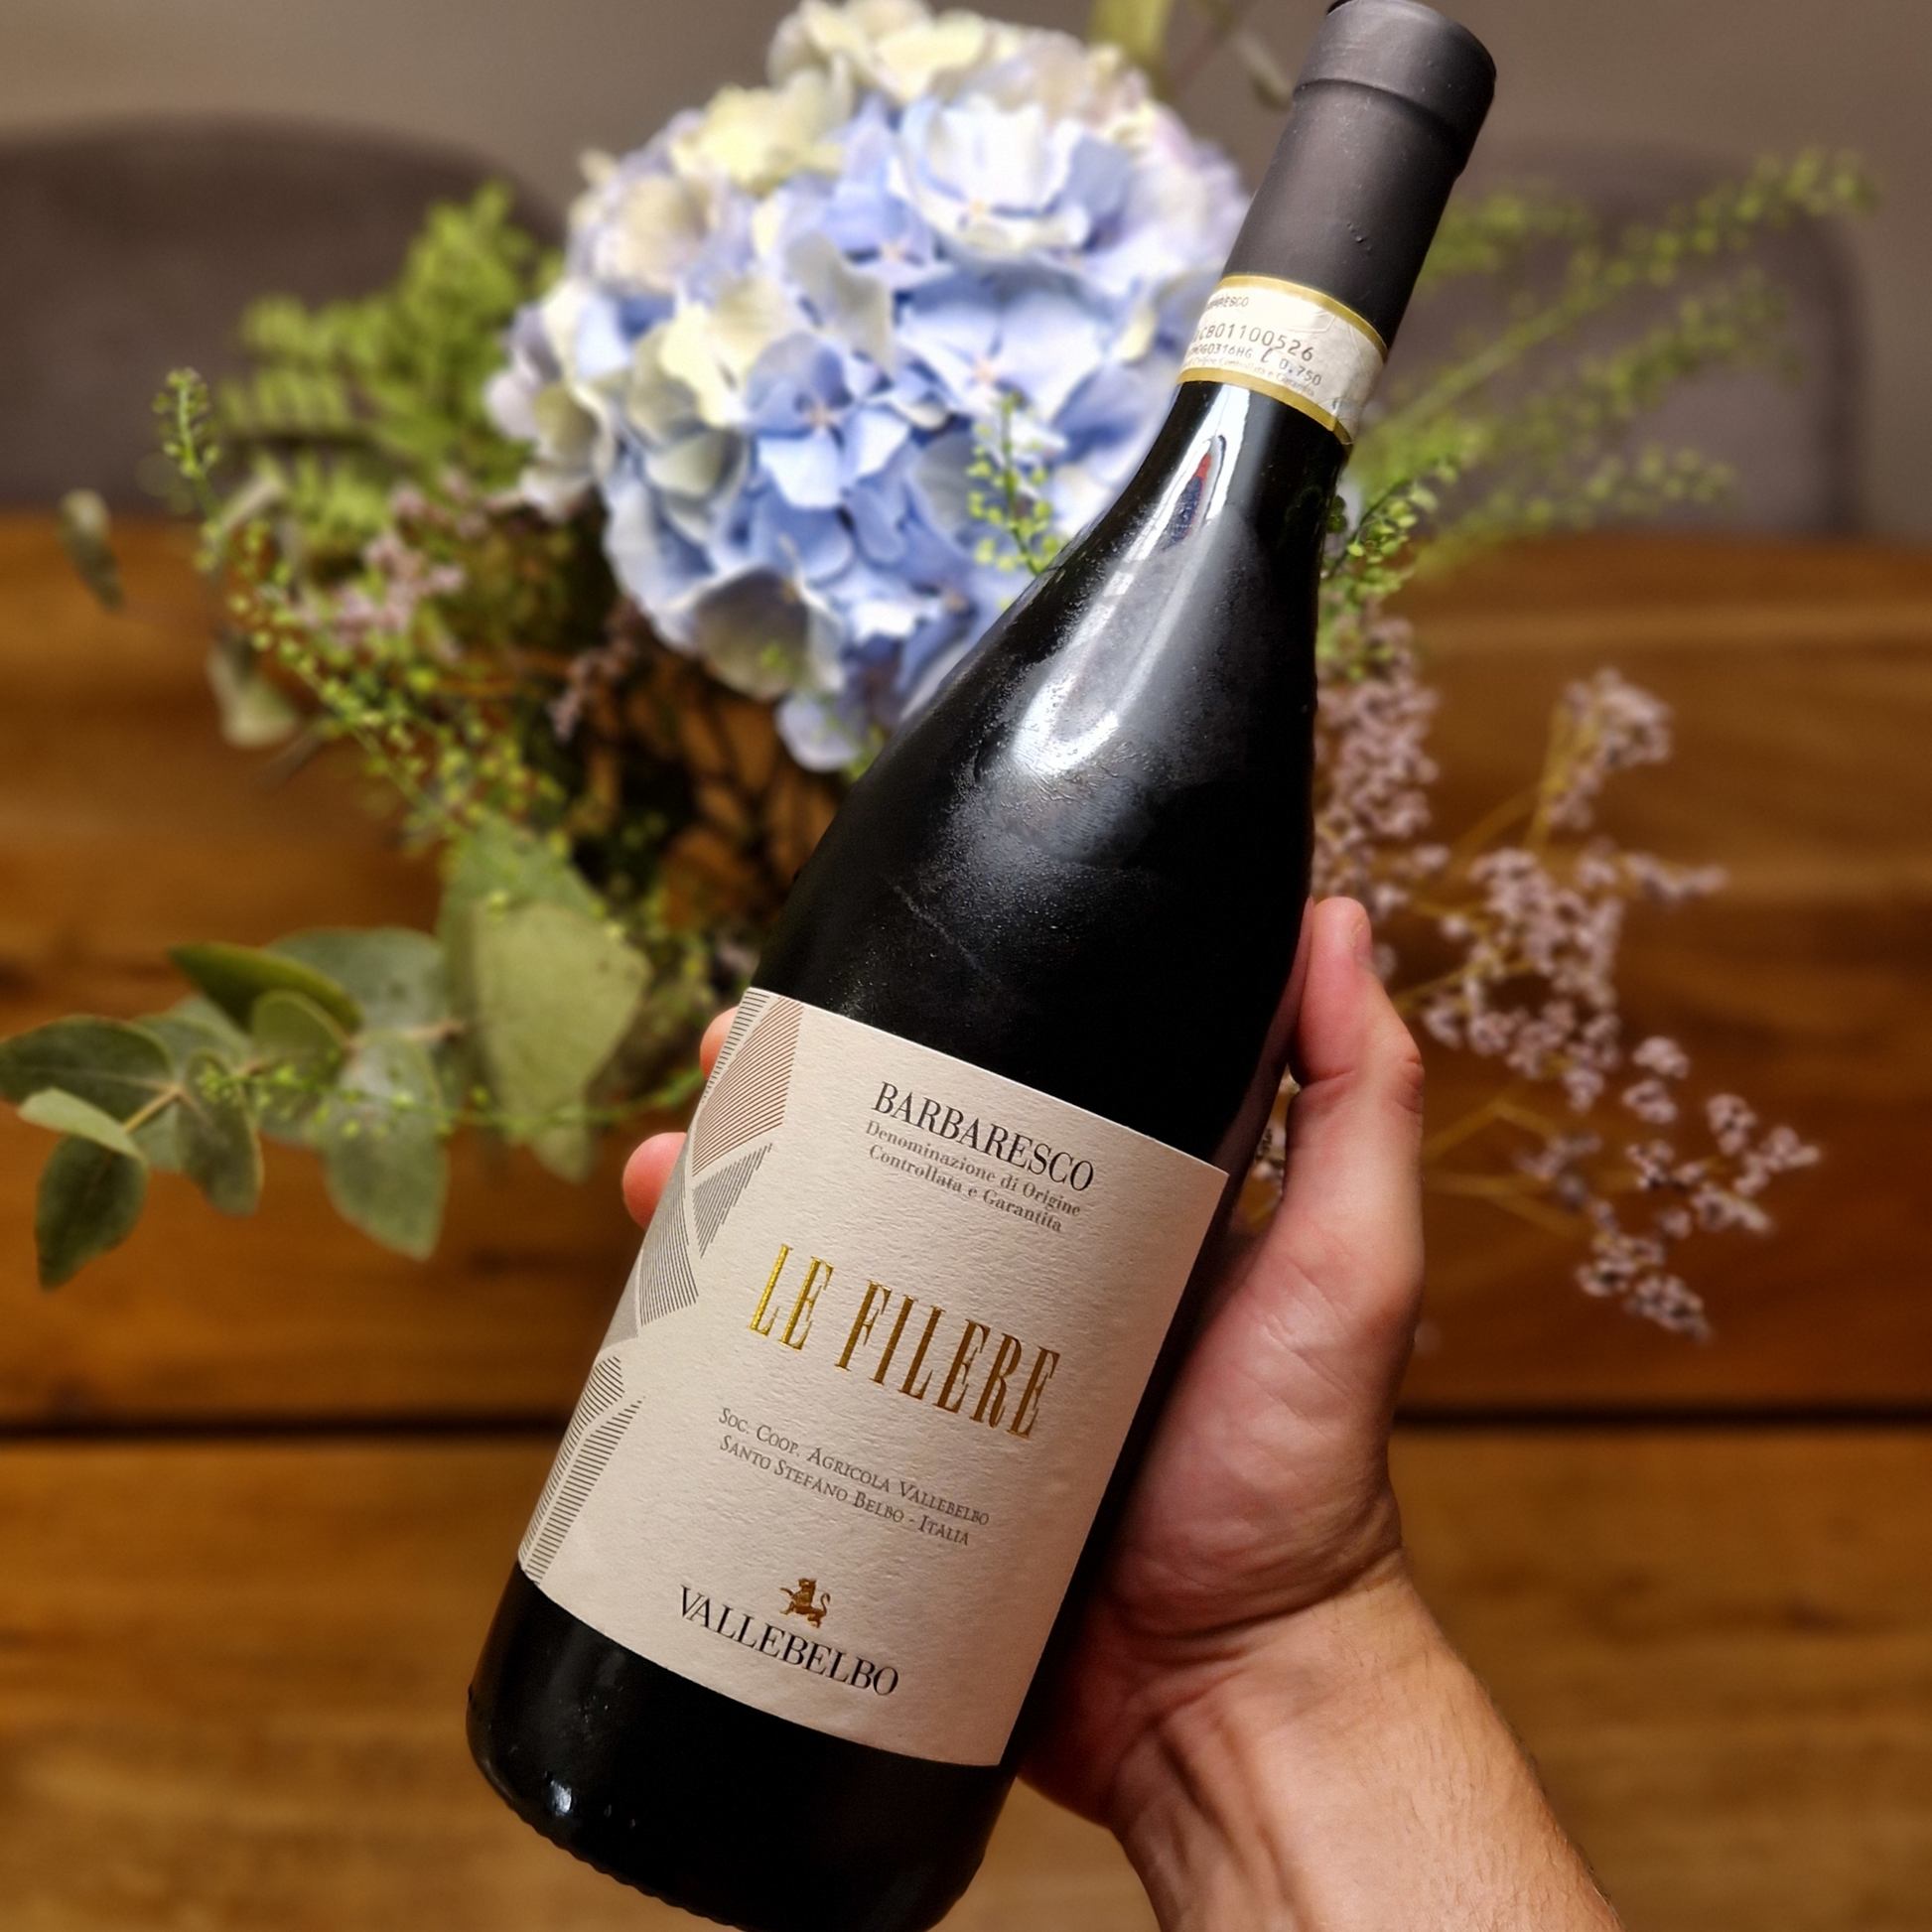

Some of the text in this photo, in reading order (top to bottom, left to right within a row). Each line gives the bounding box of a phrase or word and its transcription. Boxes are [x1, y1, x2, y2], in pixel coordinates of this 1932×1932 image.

[1279, 358, 1321, 386] 0.750
[865, 1120, 1081, 1218] Denominazione di Origine
[869, 1144, 1062, 1233] Controllata e Garantita
[871, 1081, 1094, 1192] BARBARESCO
[749, 1243, 1060, 1439] LE FILERE
[718, 1407, 990, 1526] SOC. COOP. AGRICOLA VALLEBELBO
[719, 1435, 772, 1470] SANTO
[773, 1458, 849, 1503] STEFANO
[852, 1490, 904, 1524] BELBO
[917, 1515, 970, 1546] ITALIA
[679, 1584, 899, 1697] VALLEBELBO
